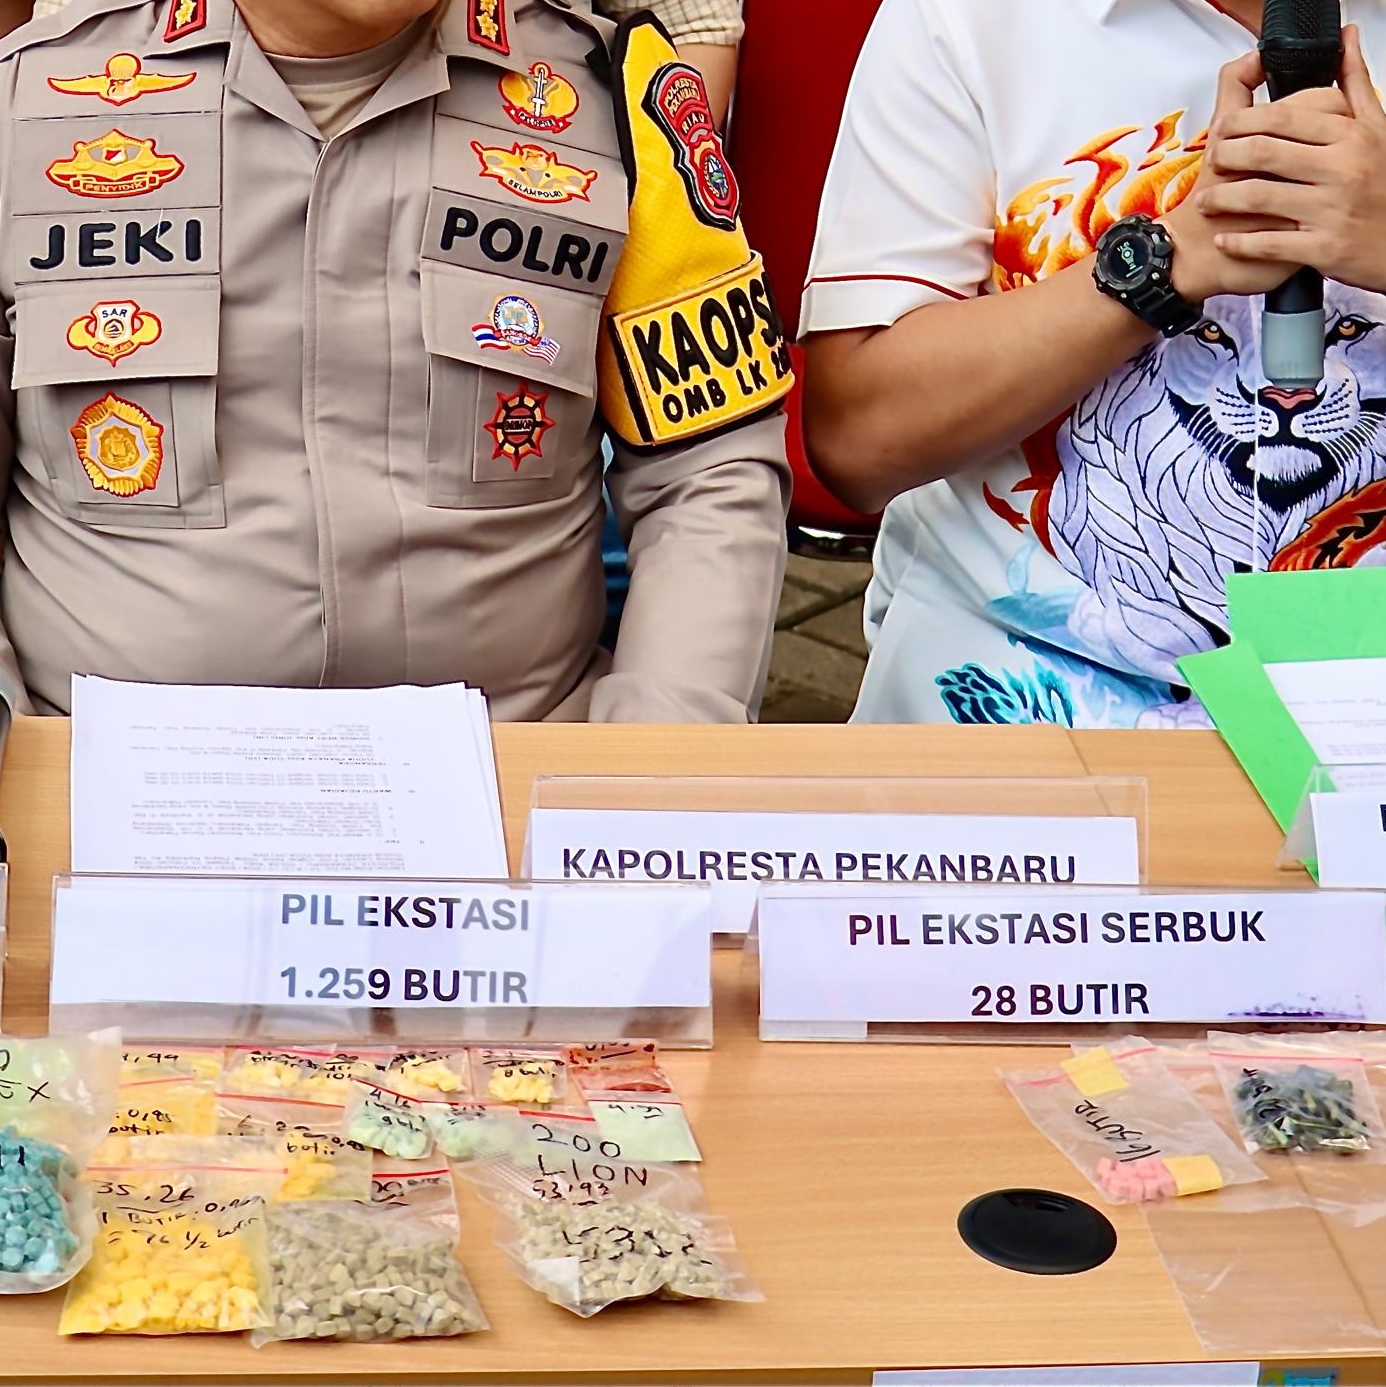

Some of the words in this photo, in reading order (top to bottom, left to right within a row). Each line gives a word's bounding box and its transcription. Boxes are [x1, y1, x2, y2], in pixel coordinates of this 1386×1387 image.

[681, 112, 706, 134] RIAU
[84, 180, 144, 193] PENYIDIK
[29, 218, 202, 271] JEKI
[440, 206, 609, 284] POLRI
[101, 307, 128, 318] SAR
[662, 378, 727, 424] OMB
[735, 359, 768, 397] LK
[564, 848, 821, 882] KAPOLRESTA
[835, 853, 1076, 884] PEKANBARU
[281, 893, 345, 927] PIL
[357, 895, 529, 931] EKSTASI
[848, 914, 911, 946] PIL
[922, 912, 1089, 945] EKSTASI
[1101, 910, 1267, 944] SERBUK
[280, 966, 391, 1001] 1.259
[403, 968, 528, 1004] BUTIR
[971, 985, 1017, 1017] 28
[1029, 983, 1150, 1016] BUTIR
[532, 1123, 621, 1159] 200
[538, 1154, 648, 1187] LION
